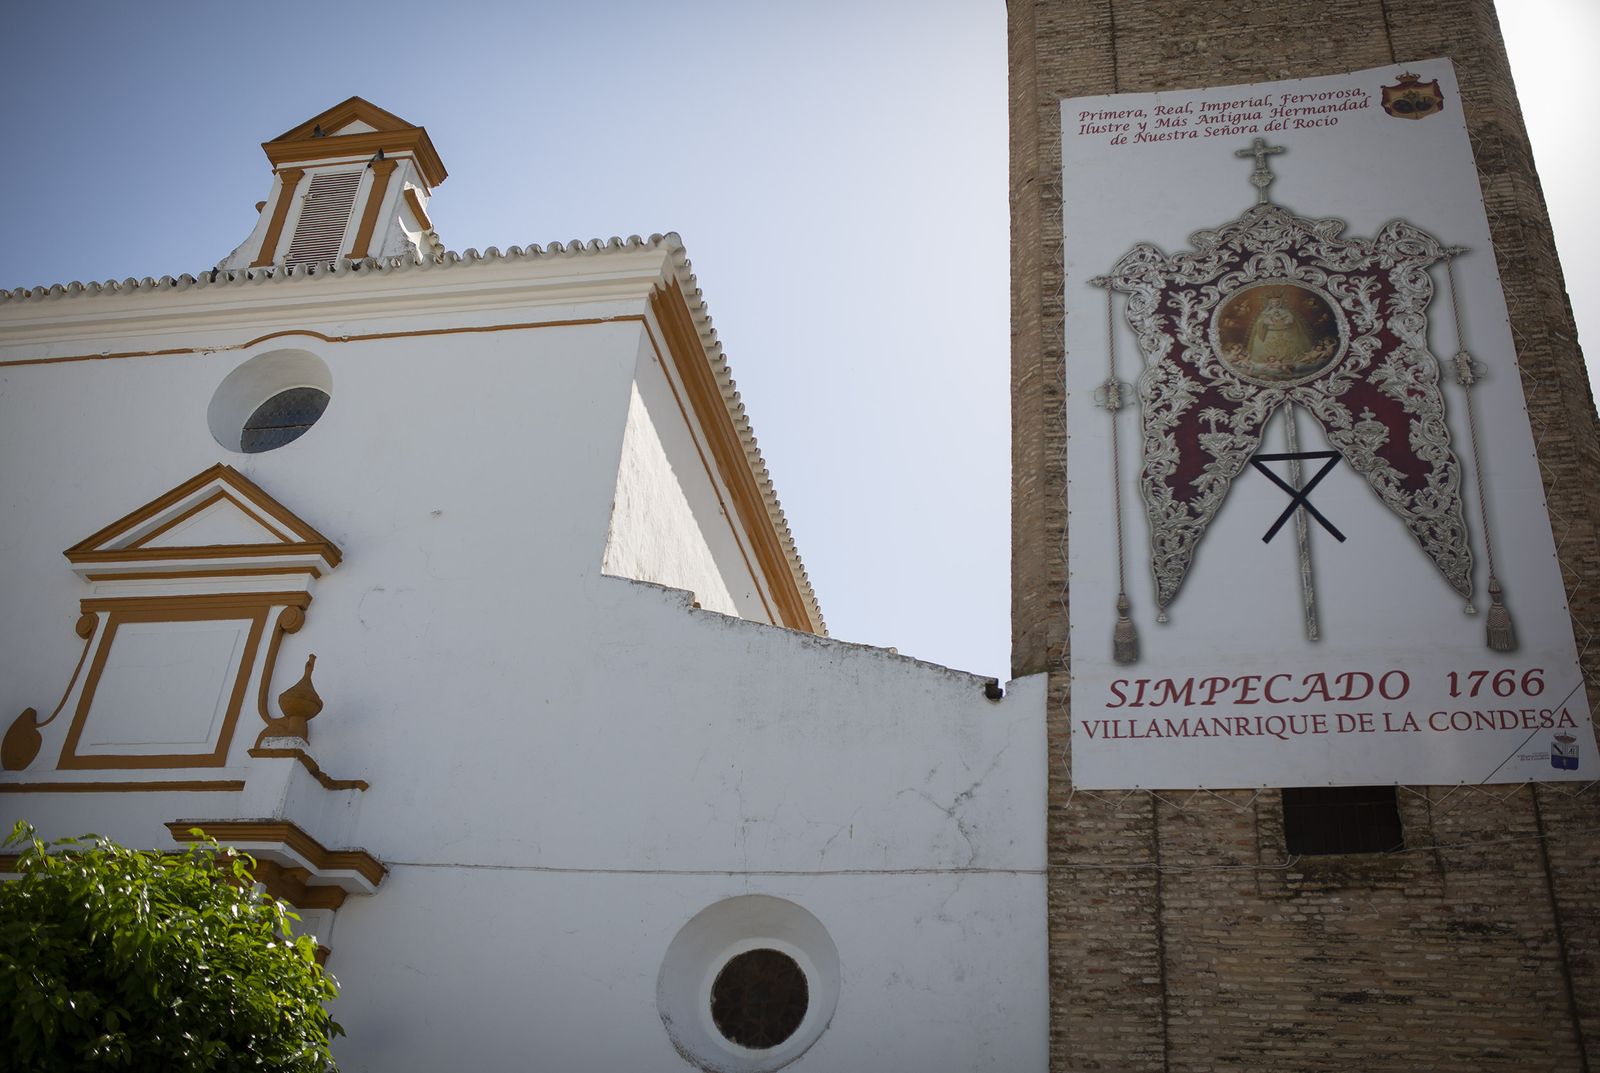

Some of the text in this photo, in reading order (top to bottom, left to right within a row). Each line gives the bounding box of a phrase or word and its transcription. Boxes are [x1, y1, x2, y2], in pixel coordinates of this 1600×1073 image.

[1078, 96, 1371, 135] Ilustre y Más Antigua Hermandad
[1079, 88, 1366, 122] Primera, Real, Imperial, Fervorosa,
[1110, 133, 1127, 145] de
[1133, 131, 1198, 144] Nuestra
[1204, 122, 1258, 137] Señora
[1264, 118, 1289, 132] del
[1105, 668, 1545, 708] SIMPECADO 1766
[1081, 707, 1578, 740] VILLAMANRIQUE DE LA CONDESA
